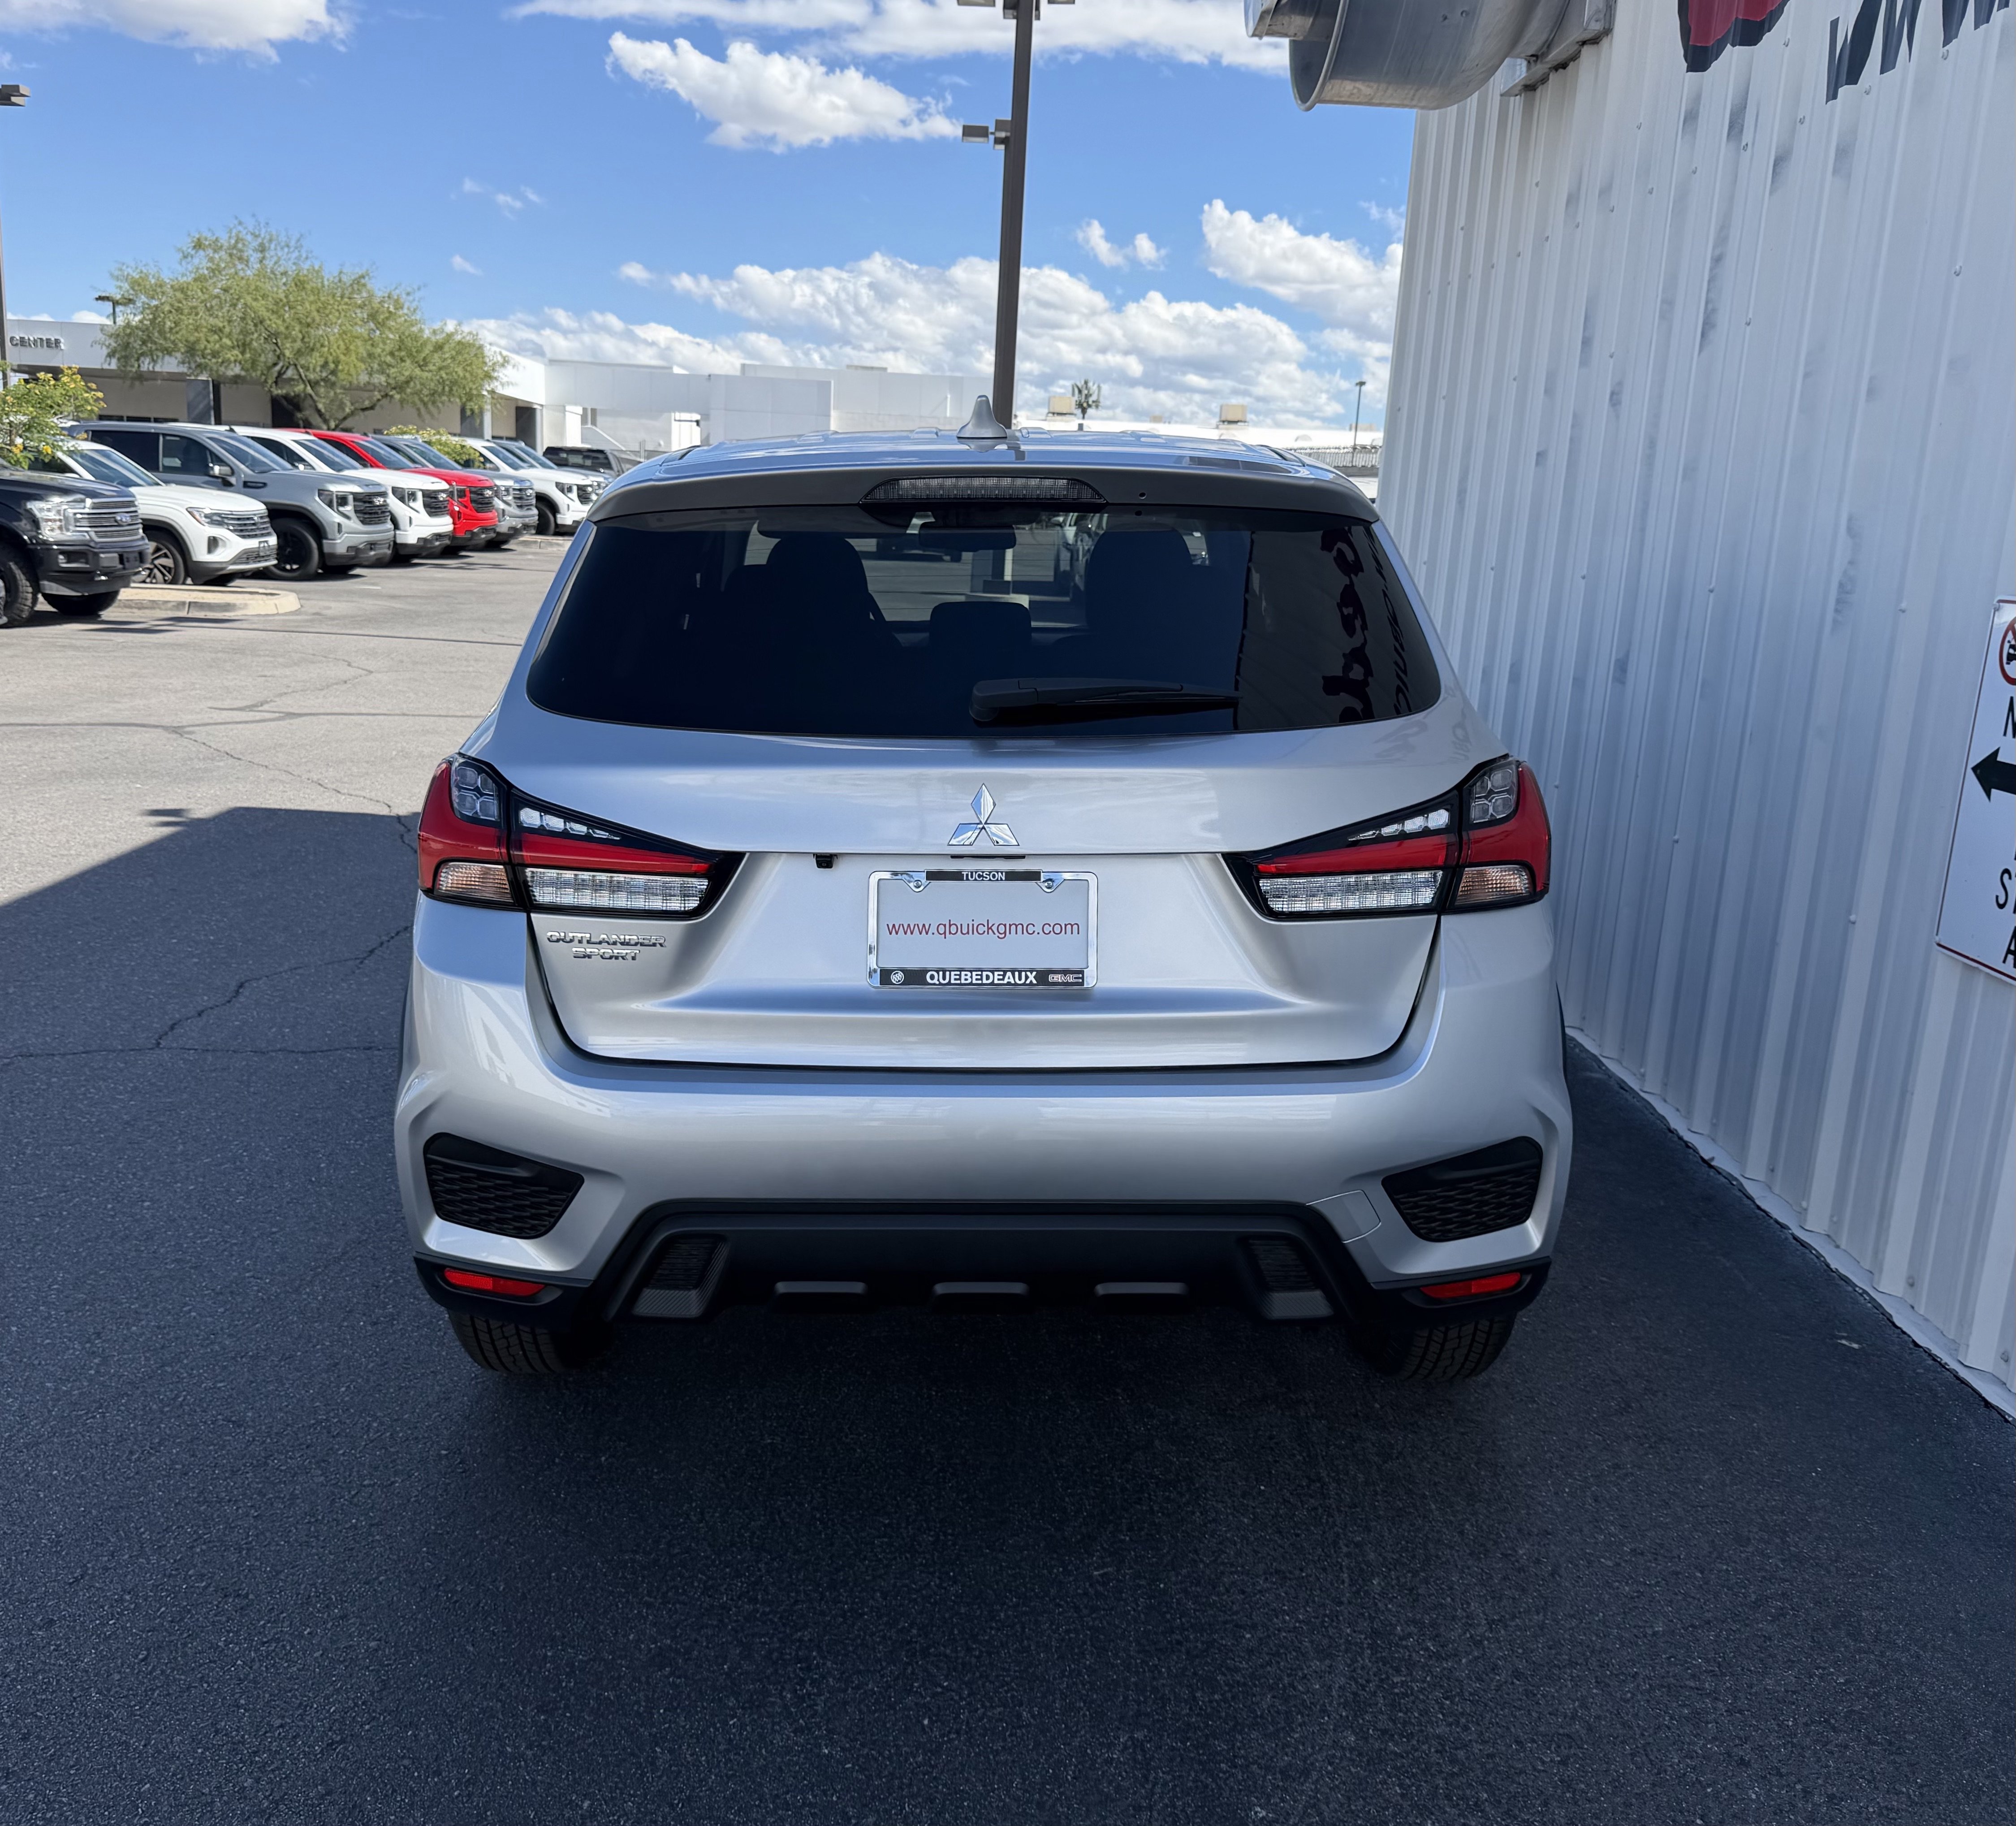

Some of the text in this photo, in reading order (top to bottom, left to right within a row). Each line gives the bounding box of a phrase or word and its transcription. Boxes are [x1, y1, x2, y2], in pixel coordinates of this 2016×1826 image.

[9, 336, 64, 350] CENTER
[962, 872, 1005, 880] TUCSON
[886, 919, 1080, 939] www.qbuickgmc.com
[547, 931, 666, 948] OUTLANDER
[572, 947, 640, 961] SPORT
[926, 971, 1082, 984] QUEBEDEAUX GMC
